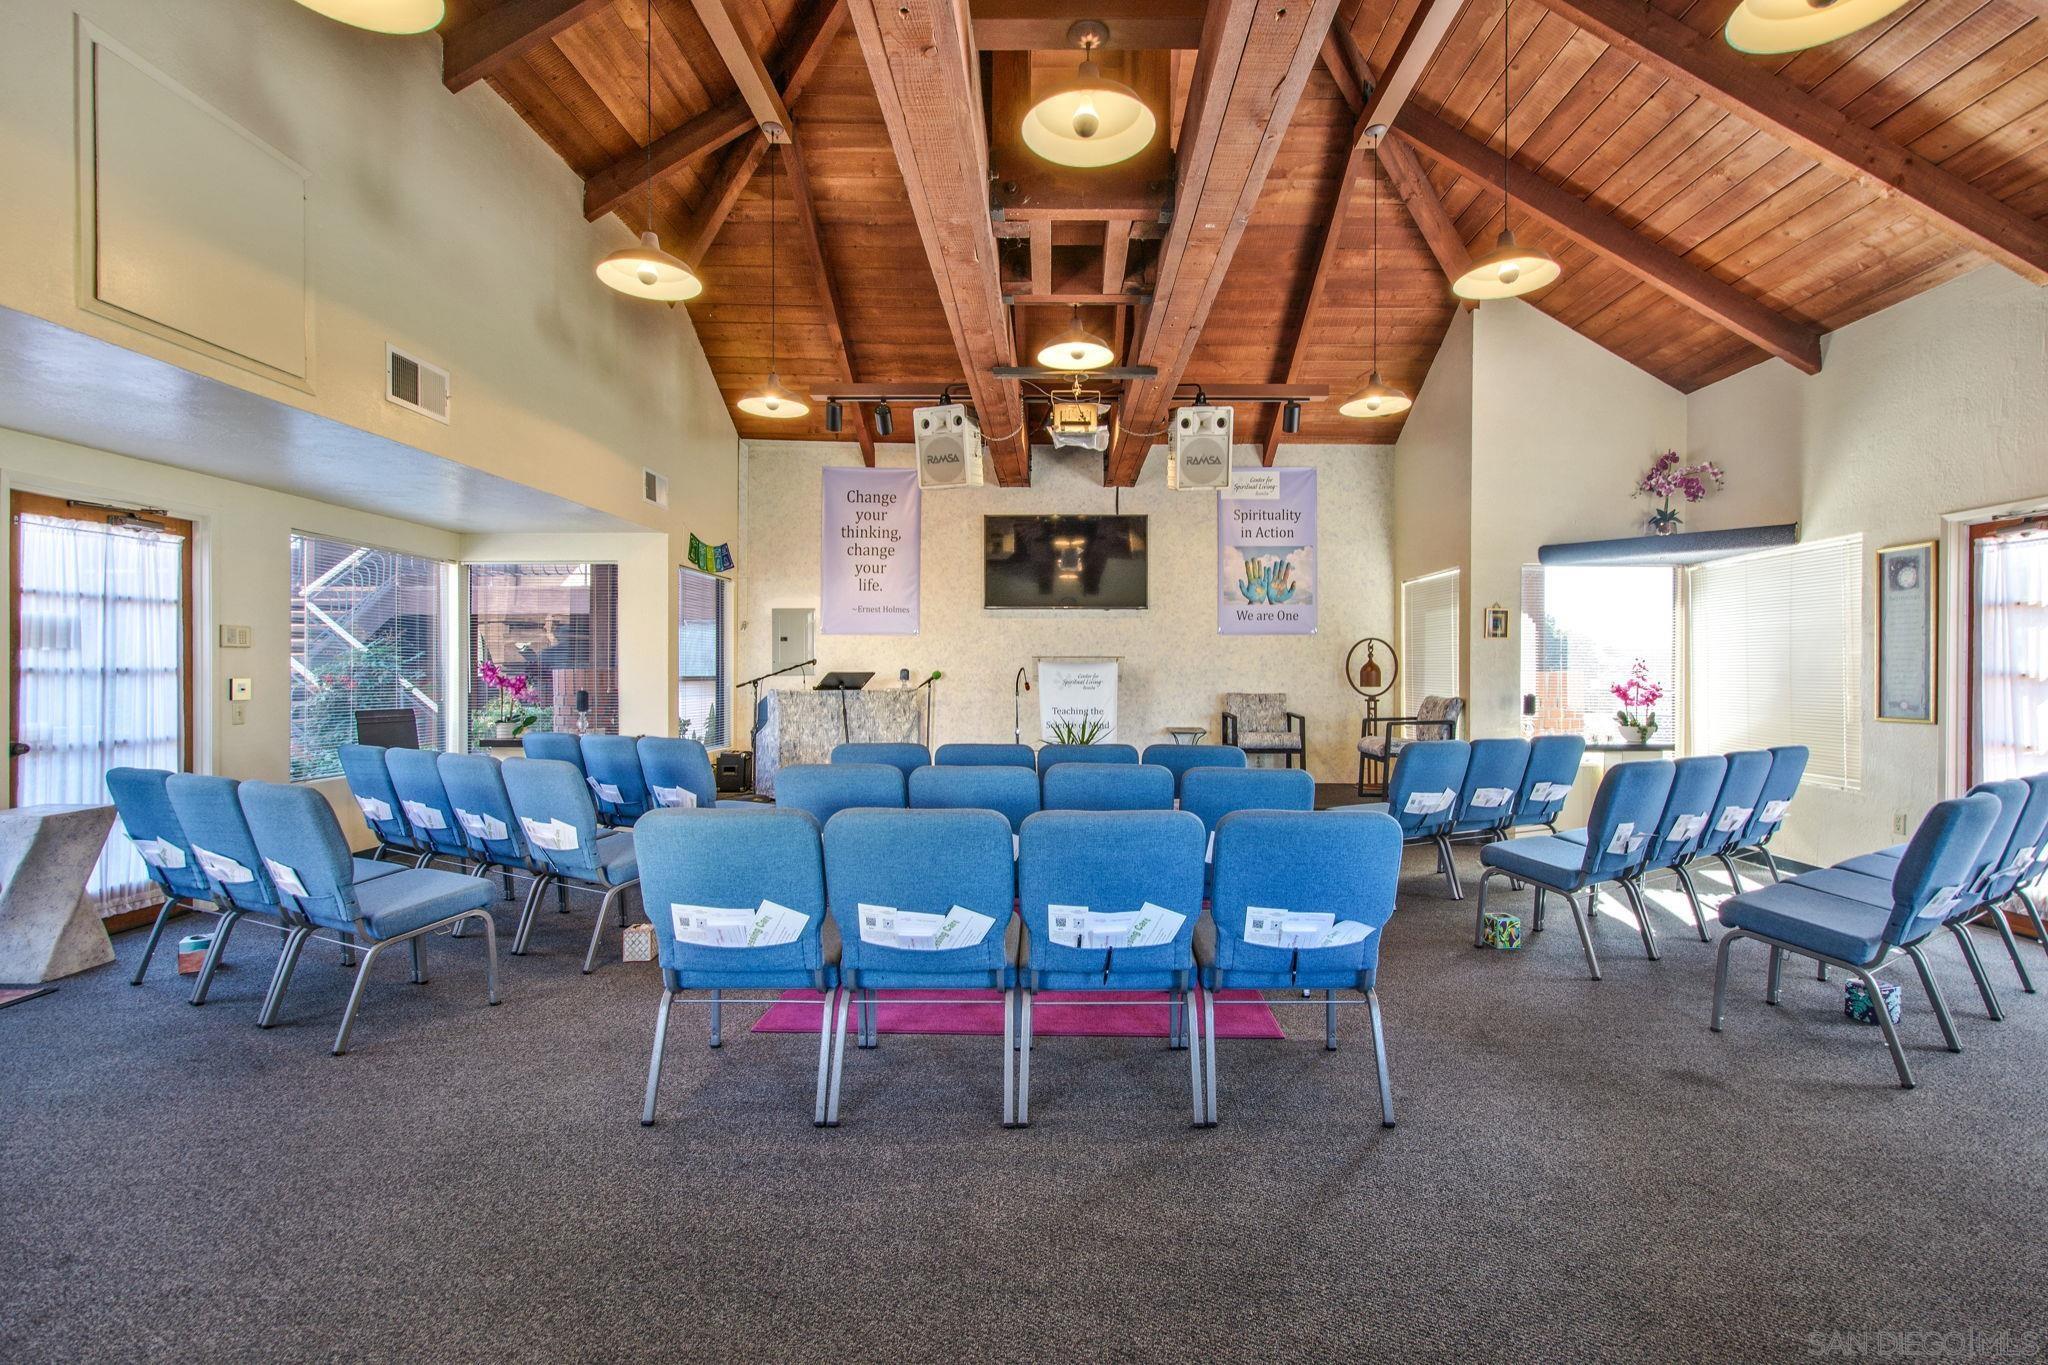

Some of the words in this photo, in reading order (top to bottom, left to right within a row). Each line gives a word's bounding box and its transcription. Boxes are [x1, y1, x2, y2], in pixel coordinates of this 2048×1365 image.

[927, 454, 960, 464] RAMSA
[1187, 456, 1221, 465] RAMSA
[1234, 483, 1258, 493] Spiritual
[1258, 483, 1277, 493] Living
[847, 490, 897, 507] Change
[855, 511, 888, 524] your
[1233, 508, 1301, 524] Spirituality
[841, 525, 902, 542] thinking,
[1241, 526, 1252, 539] in
[1255, 526, 1294, 539] Action
[847, 543, 895, 559] change
[854, 563, 887, 577] your
[858, 578, 883, 592] life.
[883, 605, 910, 614] Holmes
[1236, 610, 1254, 621] We
[1256, 612, 1275, 621] are
[1277, 610, 1299, 621] One
[1052, 707, 1089, 716] Teaching
[1090, 707, 1104, 715] the
